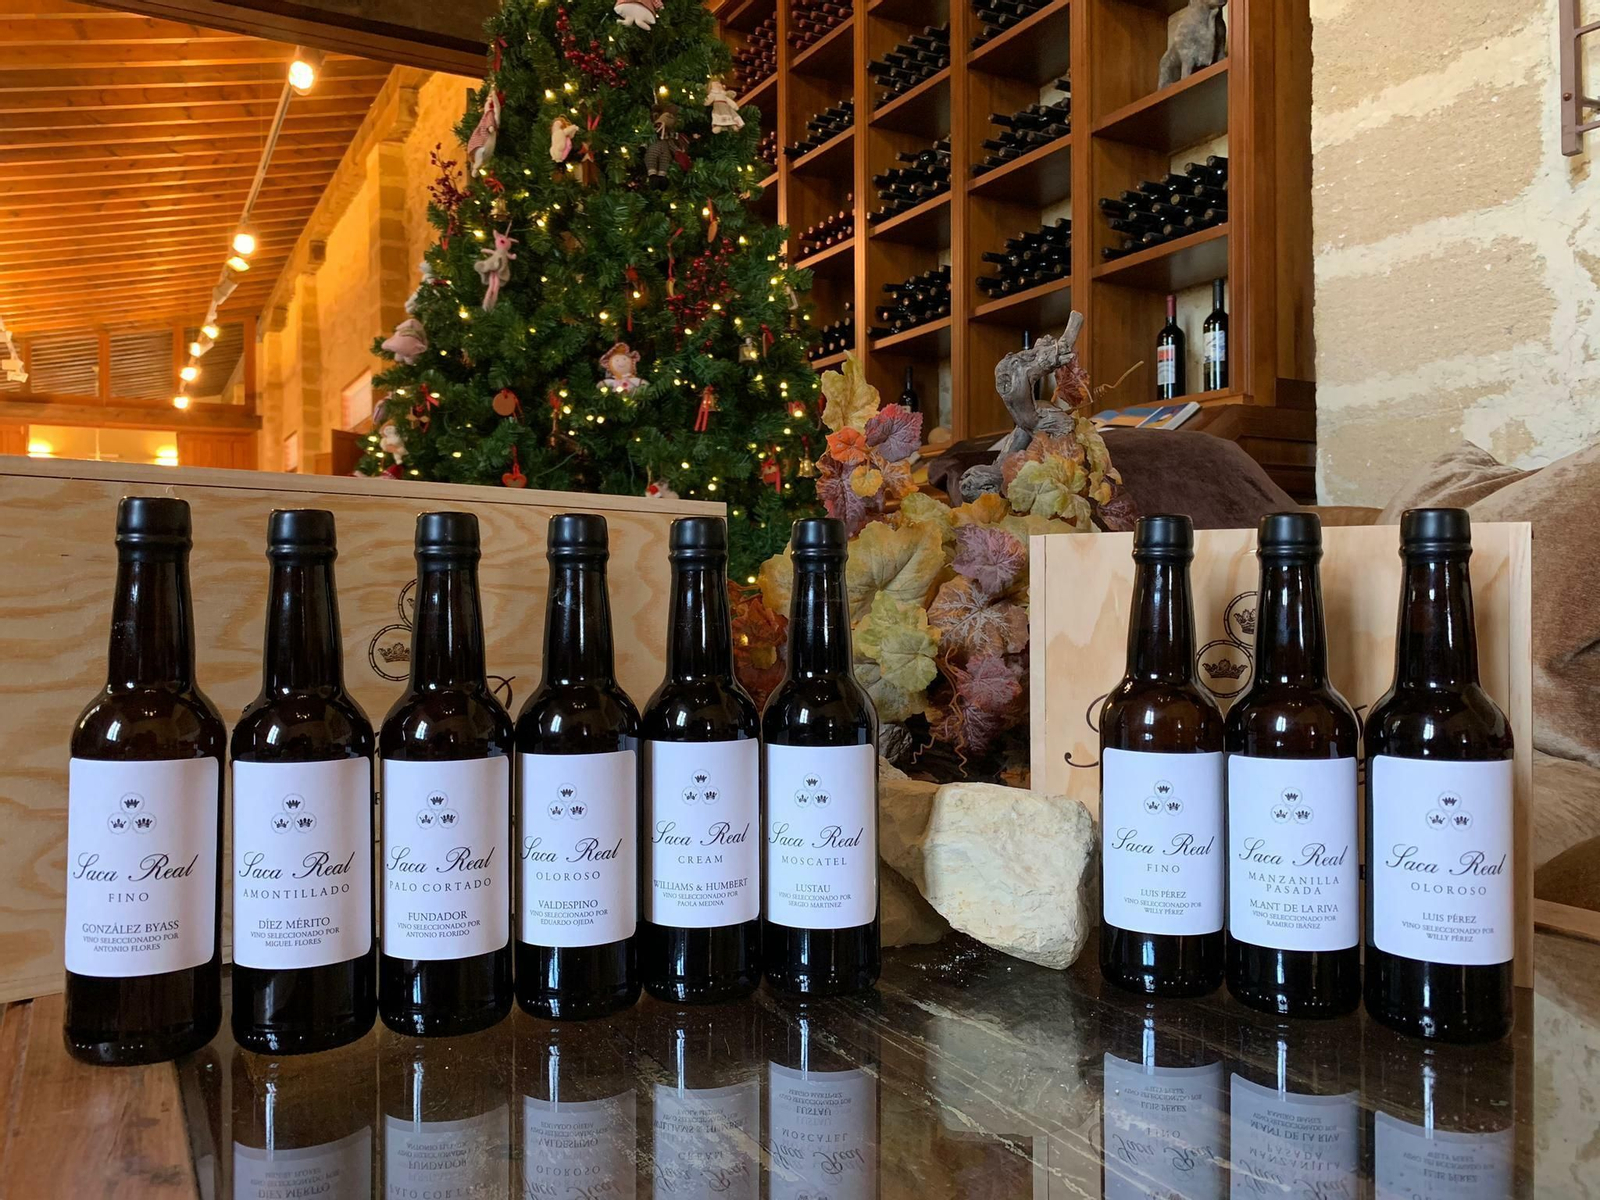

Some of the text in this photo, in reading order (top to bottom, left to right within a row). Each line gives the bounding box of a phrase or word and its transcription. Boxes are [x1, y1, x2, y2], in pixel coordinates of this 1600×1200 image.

[651, 820, 750, 846] Saca Real
[768, 821, 863, 848] Saca Real
[1112, 827, 1215, 856] Saca Real
[520, 836, 622, 863] Saca Real
[1239, 837, 1348, 867] Saca Real
[239, 850, 356, 880] Saca Real
[386, 846, 495, 873] Saca Real
[678, 855, 723, 864] CREAM
[782, 857, 847, 866] MOSCATEL
[1385, 844, 1506, 876] Saca Real
[73, 852, 198, 882] Saca Real
[1147, 863, 1180, 873] FINO
[536, 871, 600, 881] OLOROSO
[1248, 871, 1339, 885] MANZANILLA
[389, 878, 491, 892] PALO CORTADO
[706, 878, 748, 890] HUMBERT
[796, 883, 831, 892] LUSTAU
[1266, 884, 1321, 895] PASADA
[1411, 882, 1487, 895] OLOROSO
[243, 883, 350, 899] AMONTILLADO
[1141, 889, 1186, 898] LUIS PÉREZ
[108, 892, 149, 902] FINO
[538, 899, 598, 909] VALDESPINO
[1140, 900, 1189, 908] SELECCIONADO
[1284, 903, 1298, 912] DE
[1302, 905, 1314, 913] LA
[1317, 904, 1338, 913] RIVA
[408, 911, 468, 921] FUNDADOR
[1252, 910, 1268, 918] VINO
[1270, 913, 1323, 921] SELECCIONADO
[1423, 912, 1476, 923] LUIS PÉREZ
[82, 920, 179, 934] GONZÁLEZ BYASS
[258, 917, 330, 929] DÍEZ MÉRITO
[413, 922, 466, 930] SELECCIONADO
[1267, 920, 1294, 928] RAMIRO
[1402, 921, 1420, 929] VINO
[1422, 925, 1480, 934] SELECCIONADO
[268, 930, 324, 939] SELECCIONADO
[326, 927, 340, 935] POR
[439, 929, 469, 937] FLORIDO
[1426, 933, 1449, 941] WILLY
[100, 935, 161, 944] SELECCIONADO
[295, 938, 321, 946] FLORES
